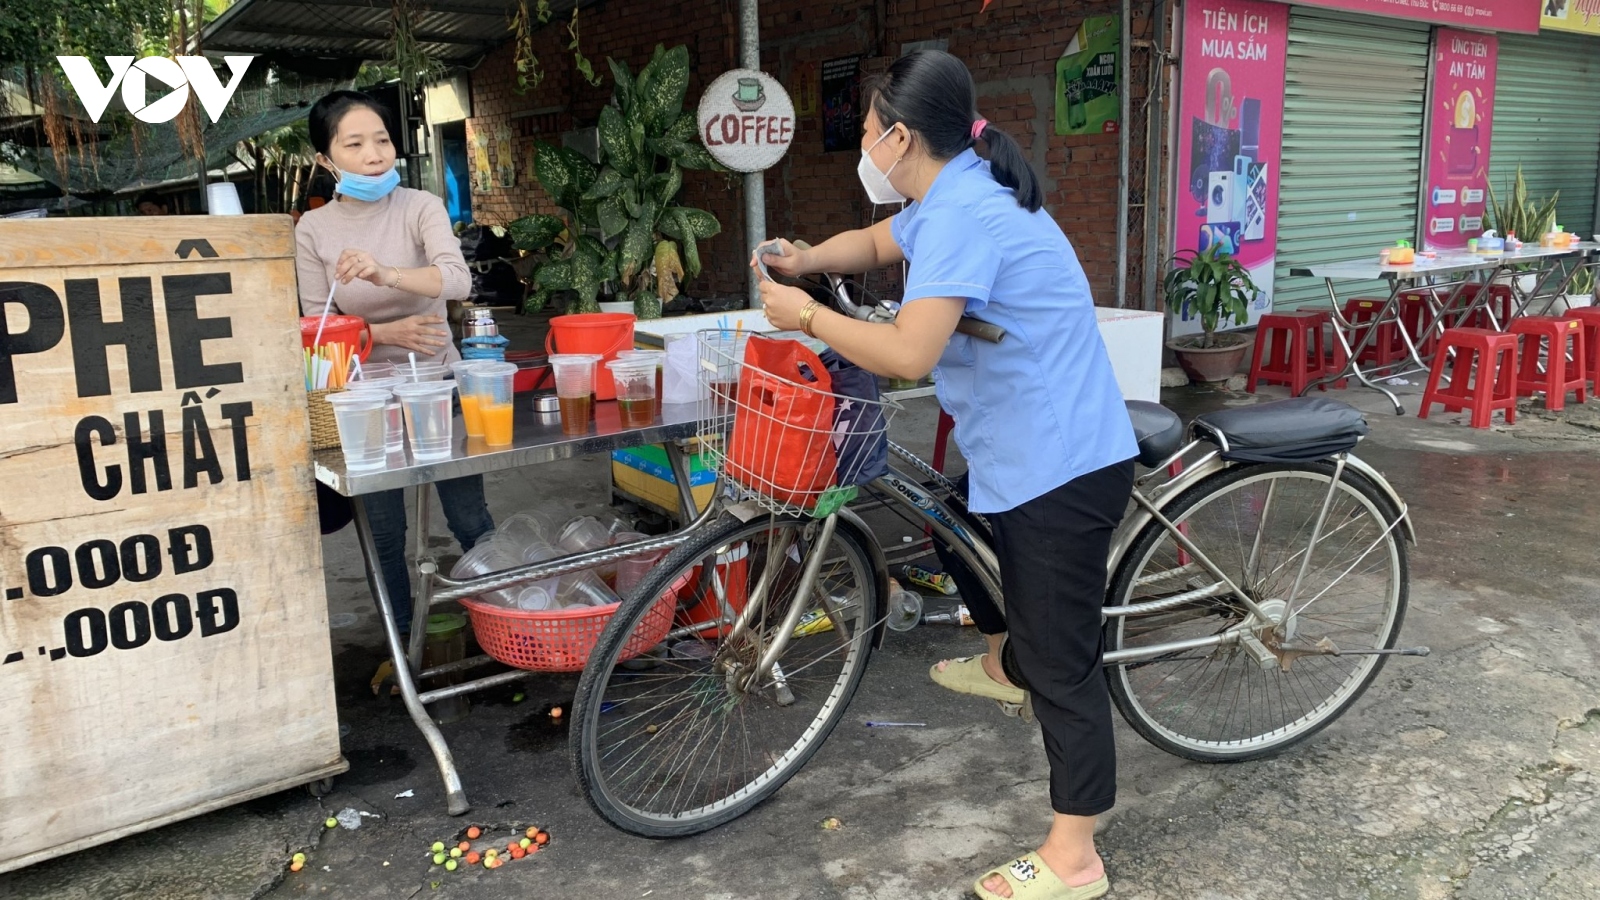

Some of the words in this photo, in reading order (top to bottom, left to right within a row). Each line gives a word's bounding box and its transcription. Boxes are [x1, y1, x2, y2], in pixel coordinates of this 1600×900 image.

[1202, 7, 1237, 35] TIỆN
[1243, 10, 1268, 34] ÍCH
[1202, 38, 1234, 59] MUA
[1237, 35, 1267, 61] SẮM
[1449, 61, 1464, 77] AN
[1466, 60, 1486, 80] TÂM
[705, 113, 791, 146] COFFEE
[0, 238, 244, 403] PHÊ
[74, 387, 254, 501] CHẤT
